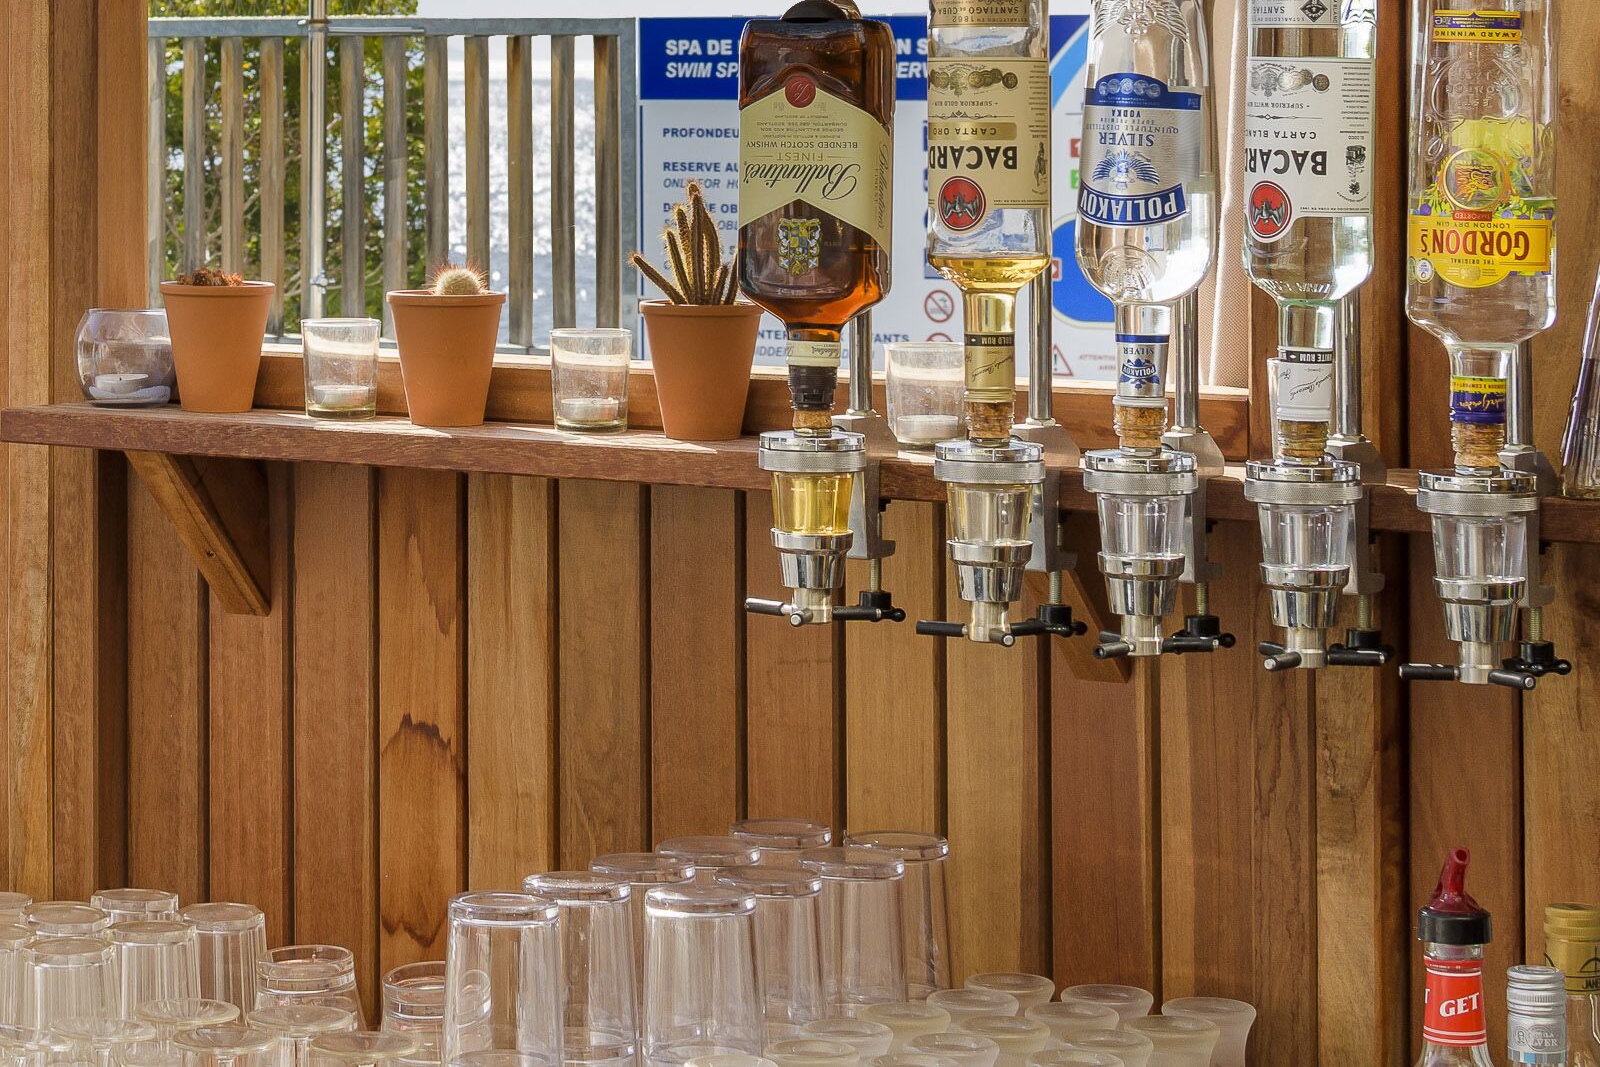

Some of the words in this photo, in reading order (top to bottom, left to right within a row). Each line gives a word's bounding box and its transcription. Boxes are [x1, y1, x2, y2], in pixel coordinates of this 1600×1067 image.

[968, 6, 1019, 14] SANTIAGO
[952, 15, 974, 23] 1862
[665, 39, 702, 55] SPA
[707, 39, 732, 55] DE
[665, 62, 712, 78] SWIM
[716, 62, 739, 78] SP
[1111, 109, 1141, 118] VODKA
[663, 127, 739, 138] PROFONDEU
[1124, 125, 1179, 134] QUINTUPLE
[1245, 129, 1269, 138] BLANC
[1098, 131, 1155, 147] SILVER
[1273, 130, 1317, 140] CARTA
[776, 152, 823, 162] FINEST
[929, 145, 1018, 170] BACARD
[1244, 148, 1327, 176] BACAR
[663, 162, 721, 172] RESERVE
[725, 162, 739, 172] AU
[743, 163, 861, 201] Ballantine's
[1080, 189, 1178, 221] POLIAKOV
[1420, 229, 1530, 261] GORDON'S
[873, 334, 910, 343] ANTS
[981, 337, 996, 345] RUM
[1123, 347, 1154, 355] SILVER
[1299, 353, 1315, 362] RUM
[1317, 353, 1331, 362] HITE
[1122, 365, 1155, 377] POLIAKOV
[1439, 992, 1479, 1018] GET
